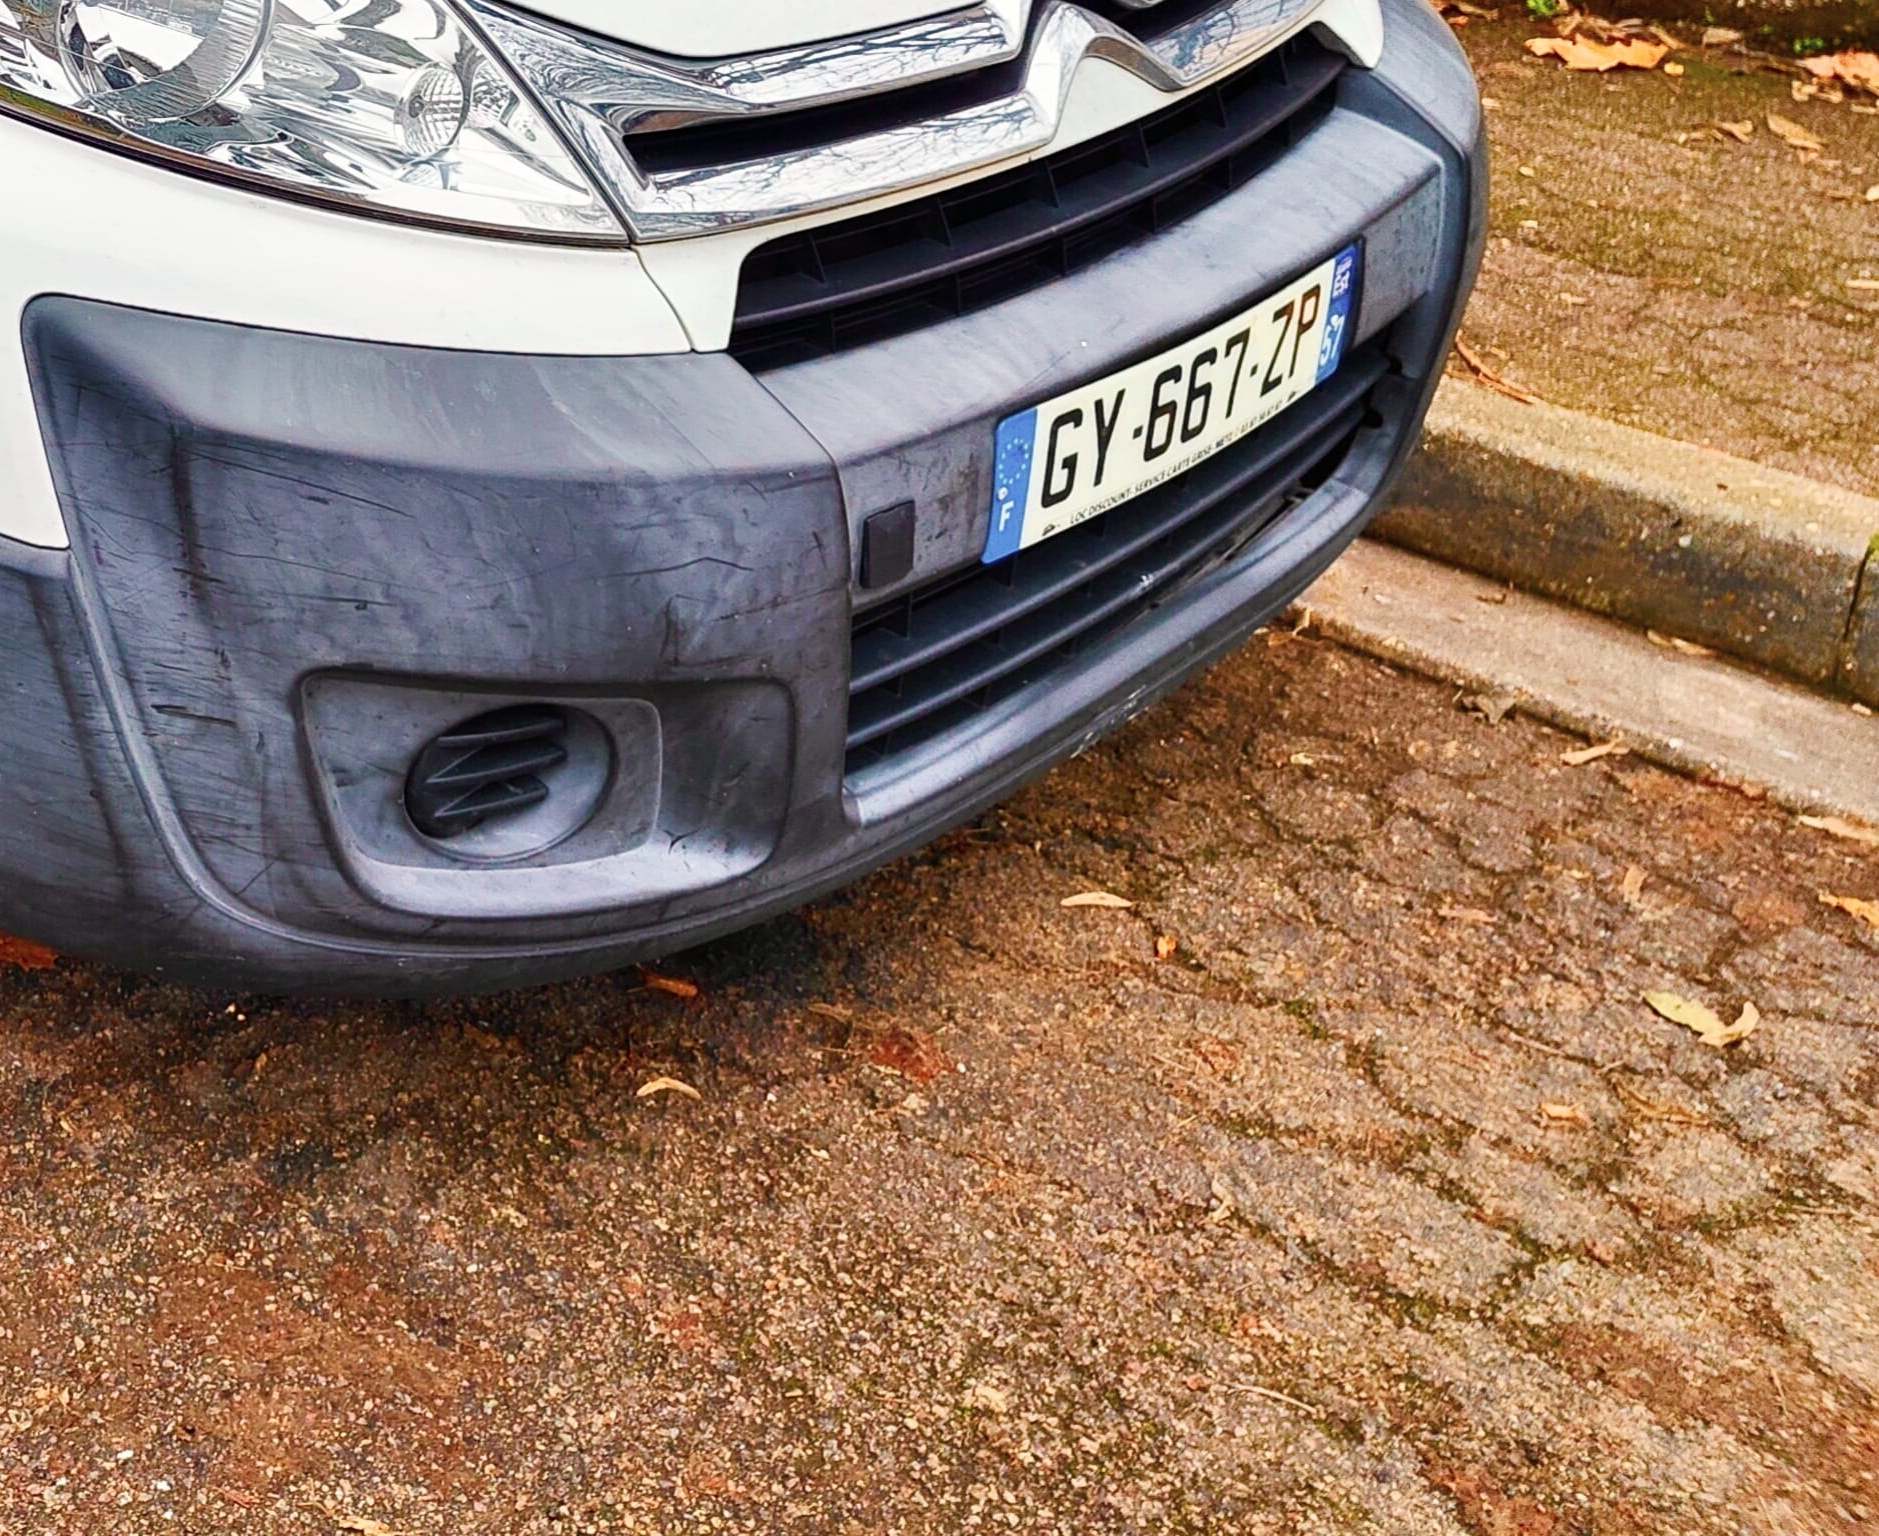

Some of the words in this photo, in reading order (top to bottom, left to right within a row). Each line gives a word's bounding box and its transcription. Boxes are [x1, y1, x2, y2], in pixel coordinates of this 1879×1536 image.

[1320, 314, 1346, 366] 57
[1040, 283, 1321, 509] GY-667-ZP
[998, 500, 1015, 533] F
